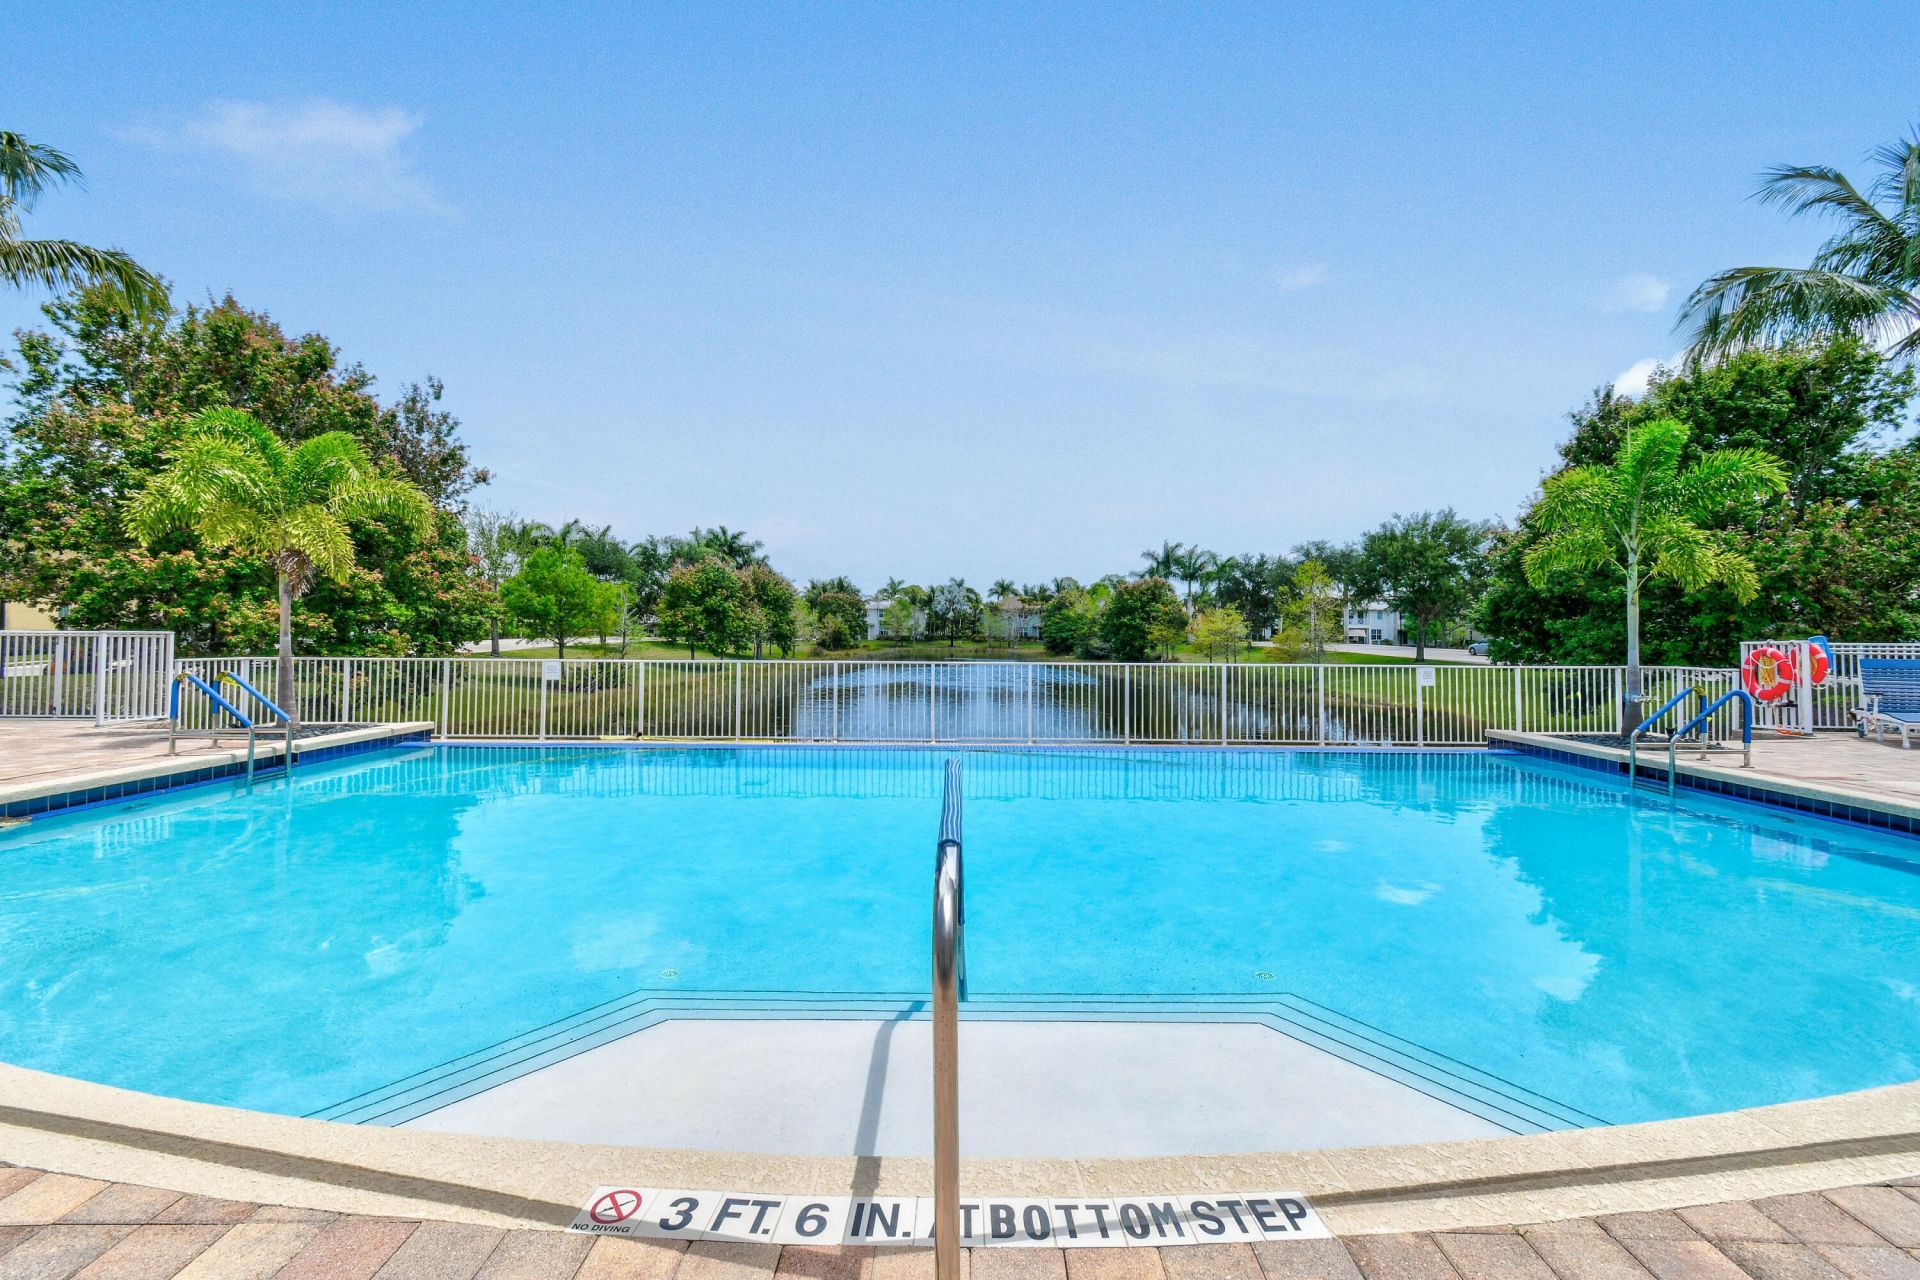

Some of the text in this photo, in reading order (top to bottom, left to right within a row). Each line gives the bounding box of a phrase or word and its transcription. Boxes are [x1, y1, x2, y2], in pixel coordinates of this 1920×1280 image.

[571, 1223, 630, 1233] NO DIVING
[659, 1197, 1307, 1240] 3 FT. 6 IN. T BOTTOM STEP
